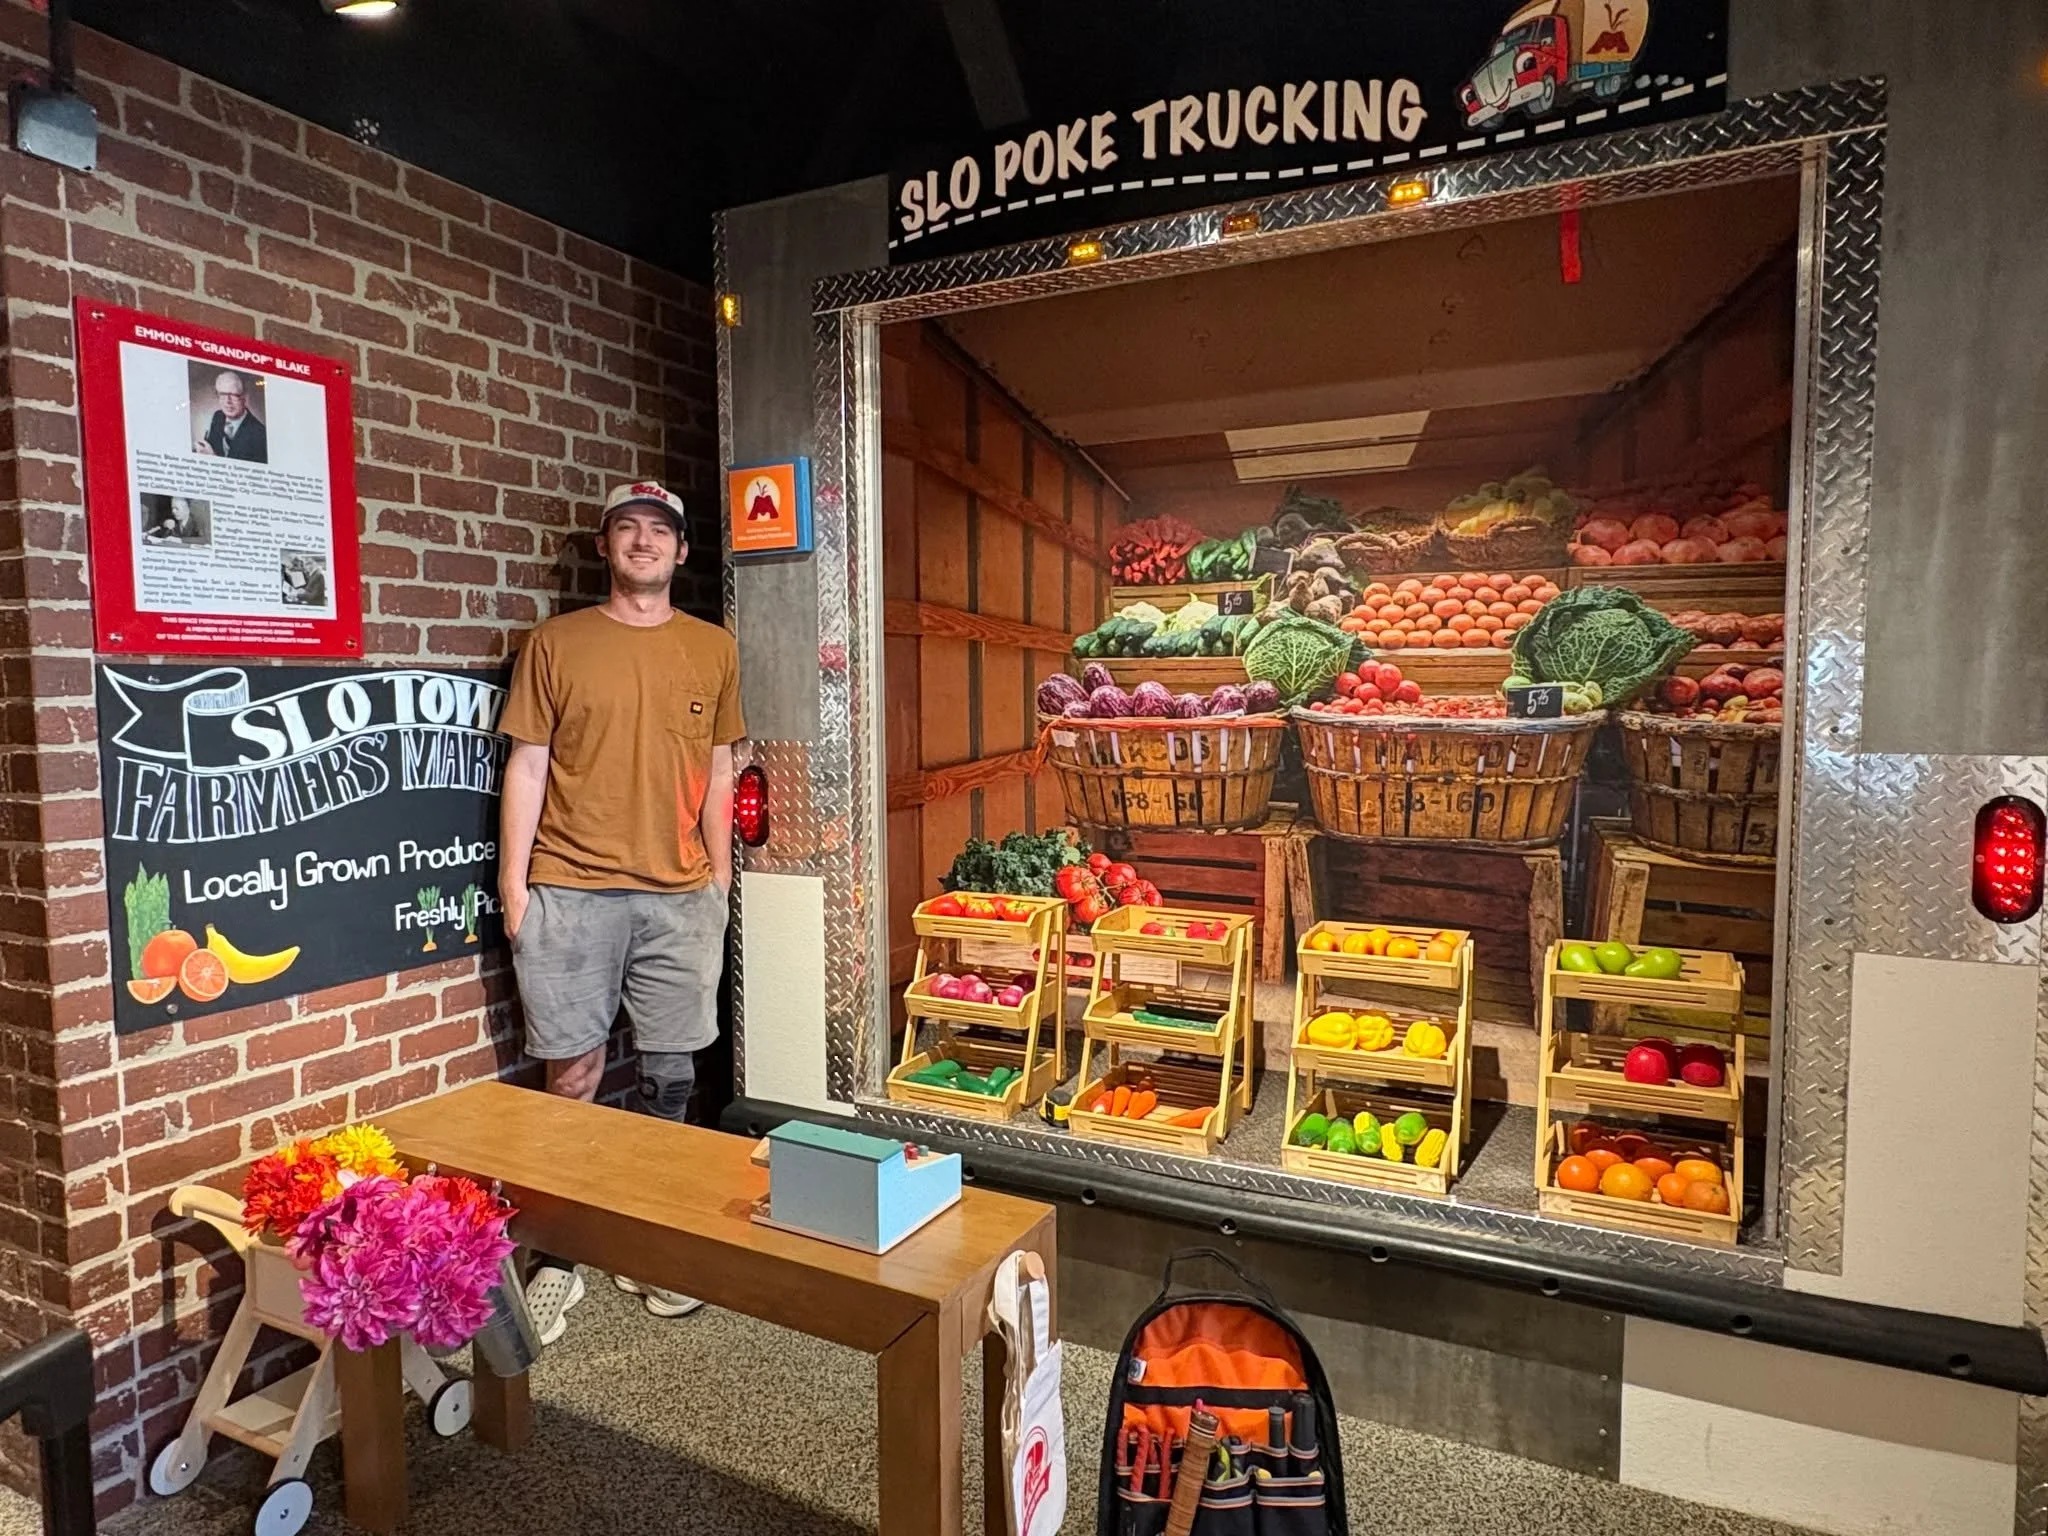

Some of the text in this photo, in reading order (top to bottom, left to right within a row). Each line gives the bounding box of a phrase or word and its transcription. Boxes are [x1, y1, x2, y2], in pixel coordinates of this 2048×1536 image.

[901, 77, 1427, 233] SLO POKE TRUCKING
[134, 325, 192, 348] EMMONS
[275, 358, 311, 375] BLAKE
[231, 680, 372, 767] SLO
[184, 836, 496, 911] Locally Grown Produce
[395, 890, 505, 931] Freshly Pic
